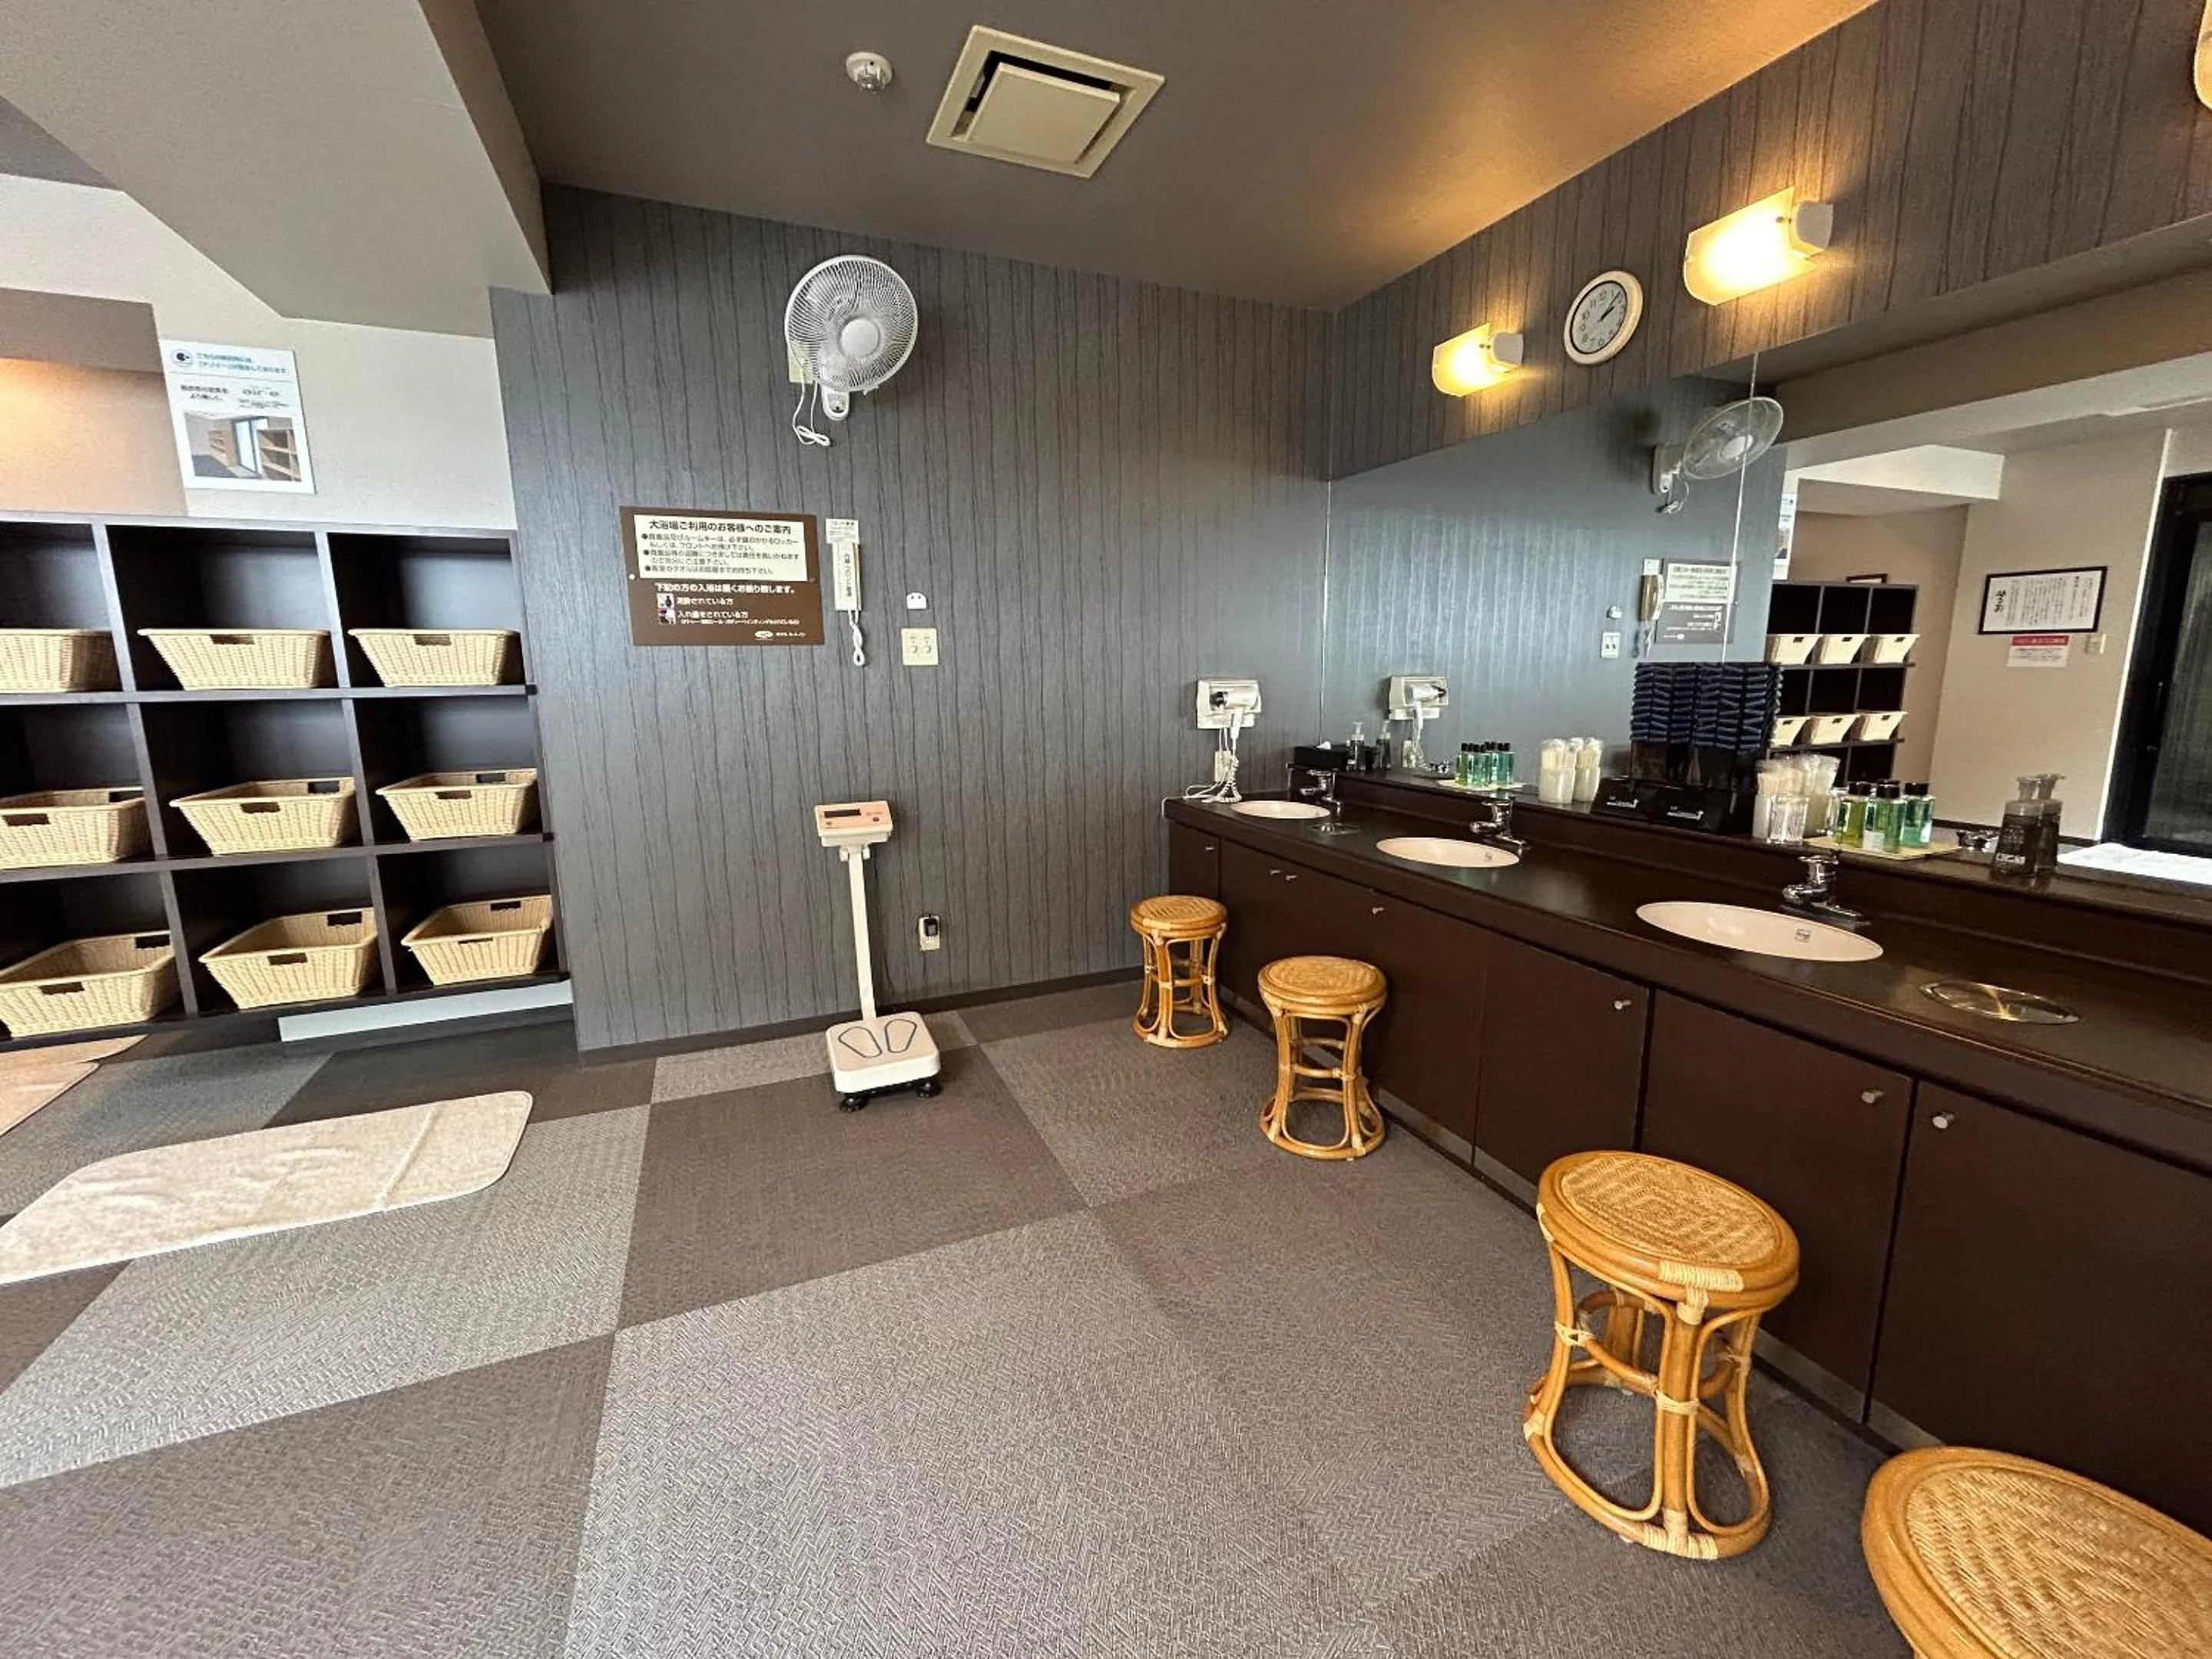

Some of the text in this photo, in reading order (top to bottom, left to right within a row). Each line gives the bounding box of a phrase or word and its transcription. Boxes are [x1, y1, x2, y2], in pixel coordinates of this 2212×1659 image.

[649, 519, 792, 535] 大浴場ご利用のお客様へのご案内
